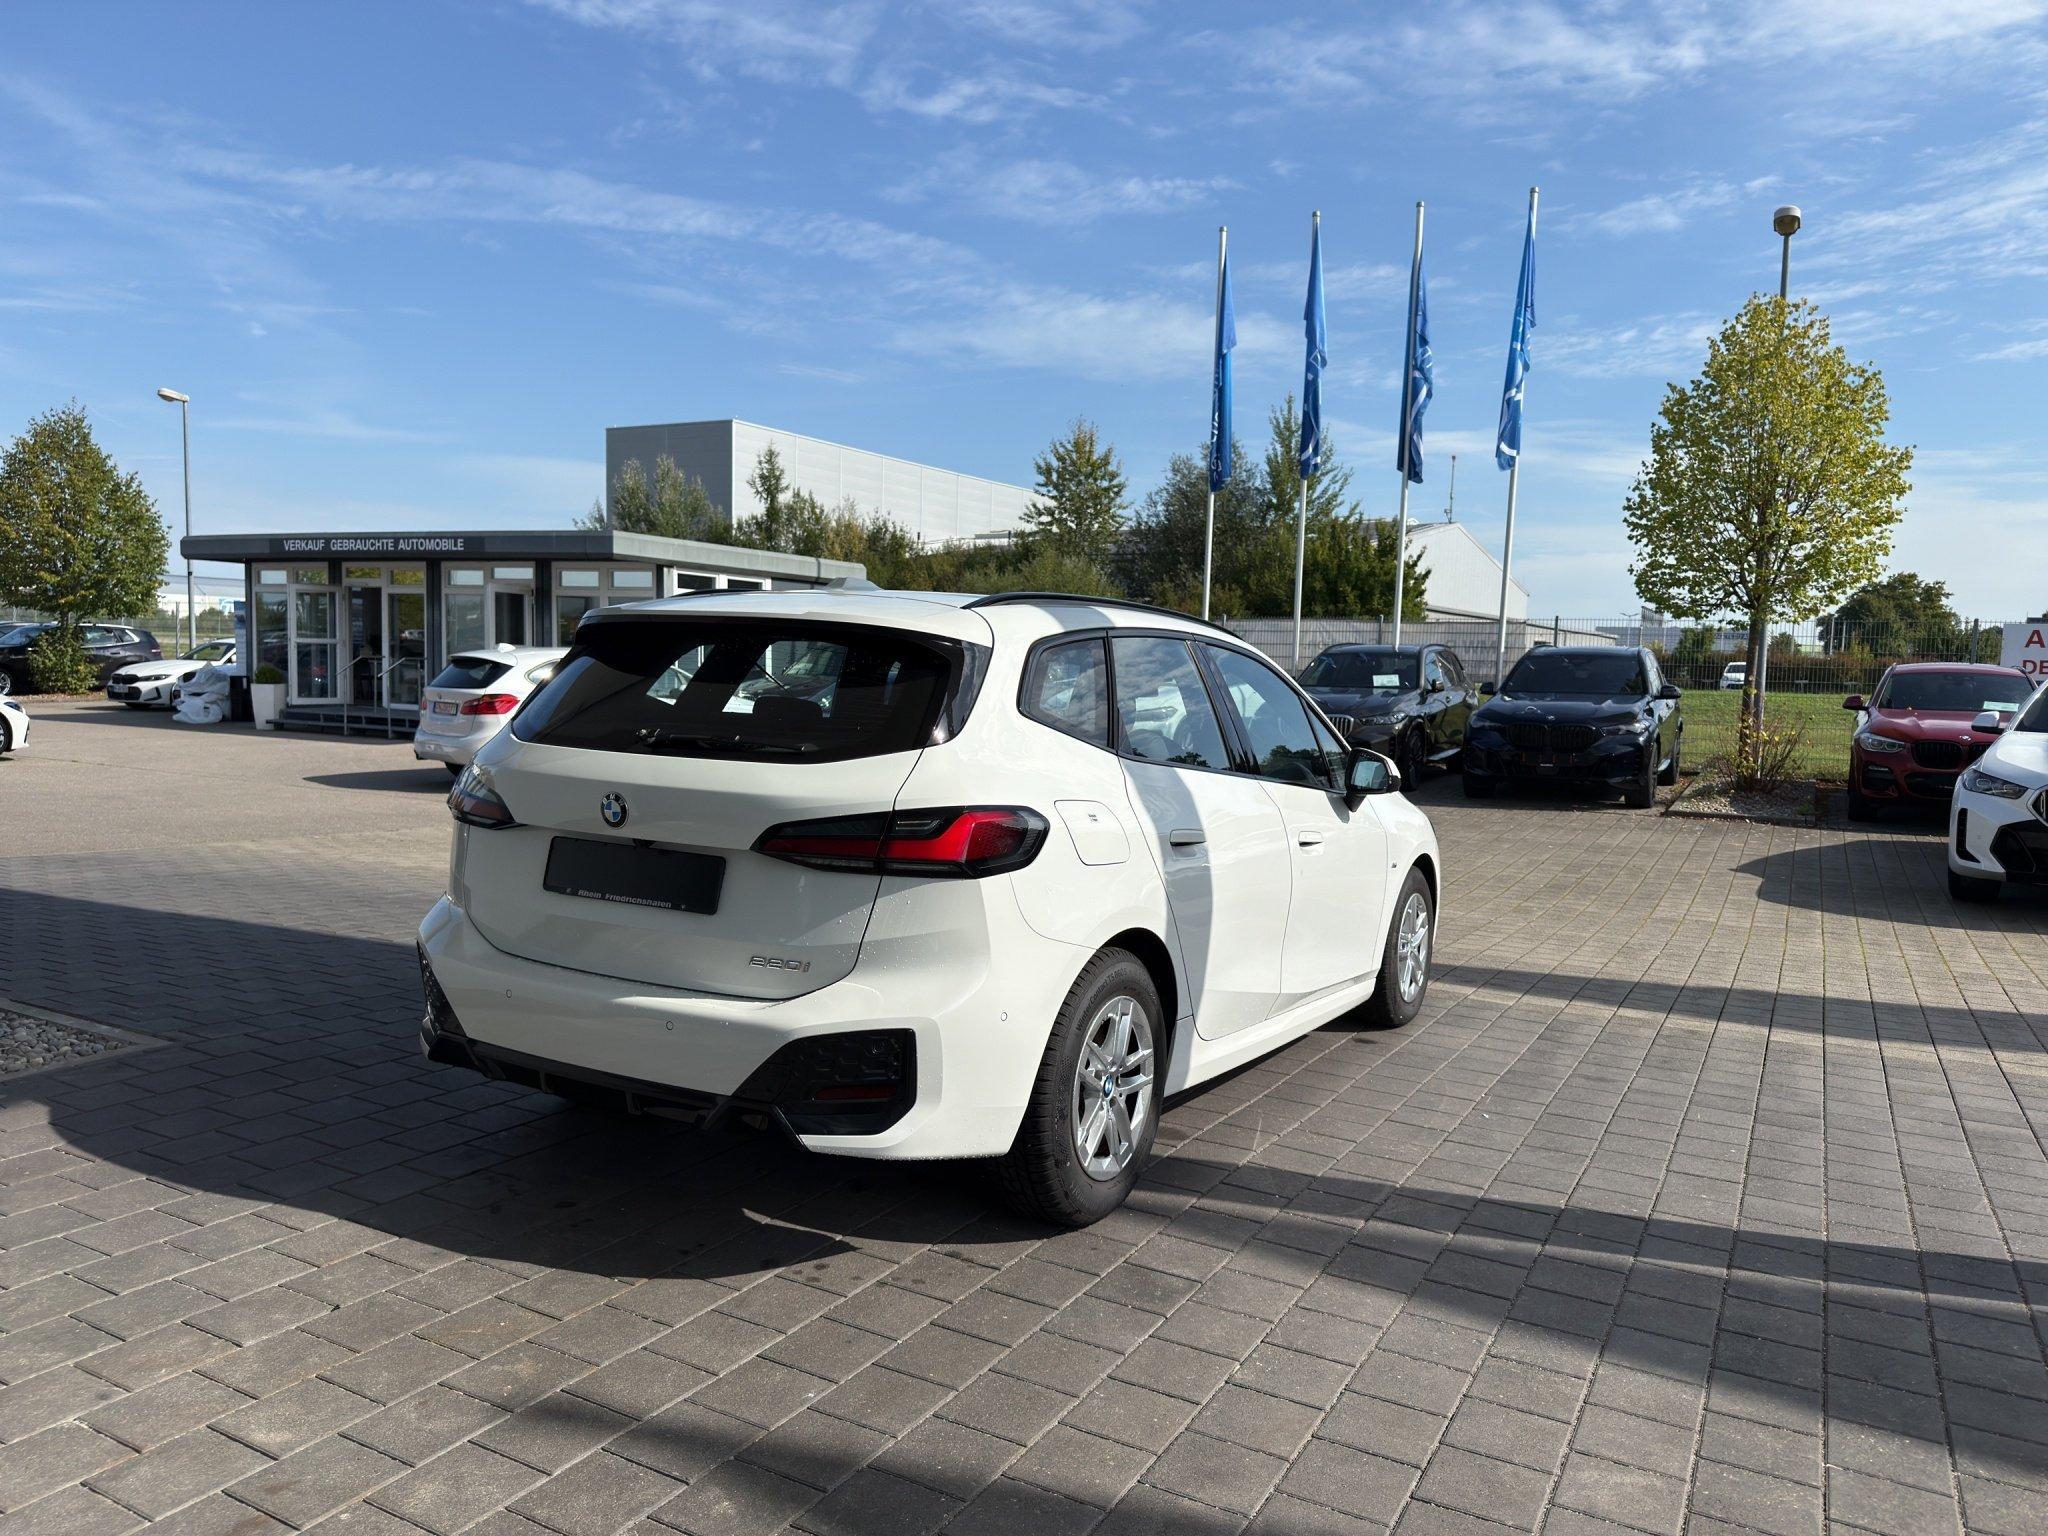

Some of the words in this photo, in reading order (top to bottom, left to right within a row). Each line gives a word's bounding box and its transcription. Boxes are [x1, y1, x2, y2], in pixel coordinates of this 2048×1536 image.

[284, 539, 325, 551] VERKAUF
[330, 539, 395, 551] GEBRAUCHTE
[398, 538, 465, 551] AUTOMOBILE
[749, 955, 811, 973] 220i
